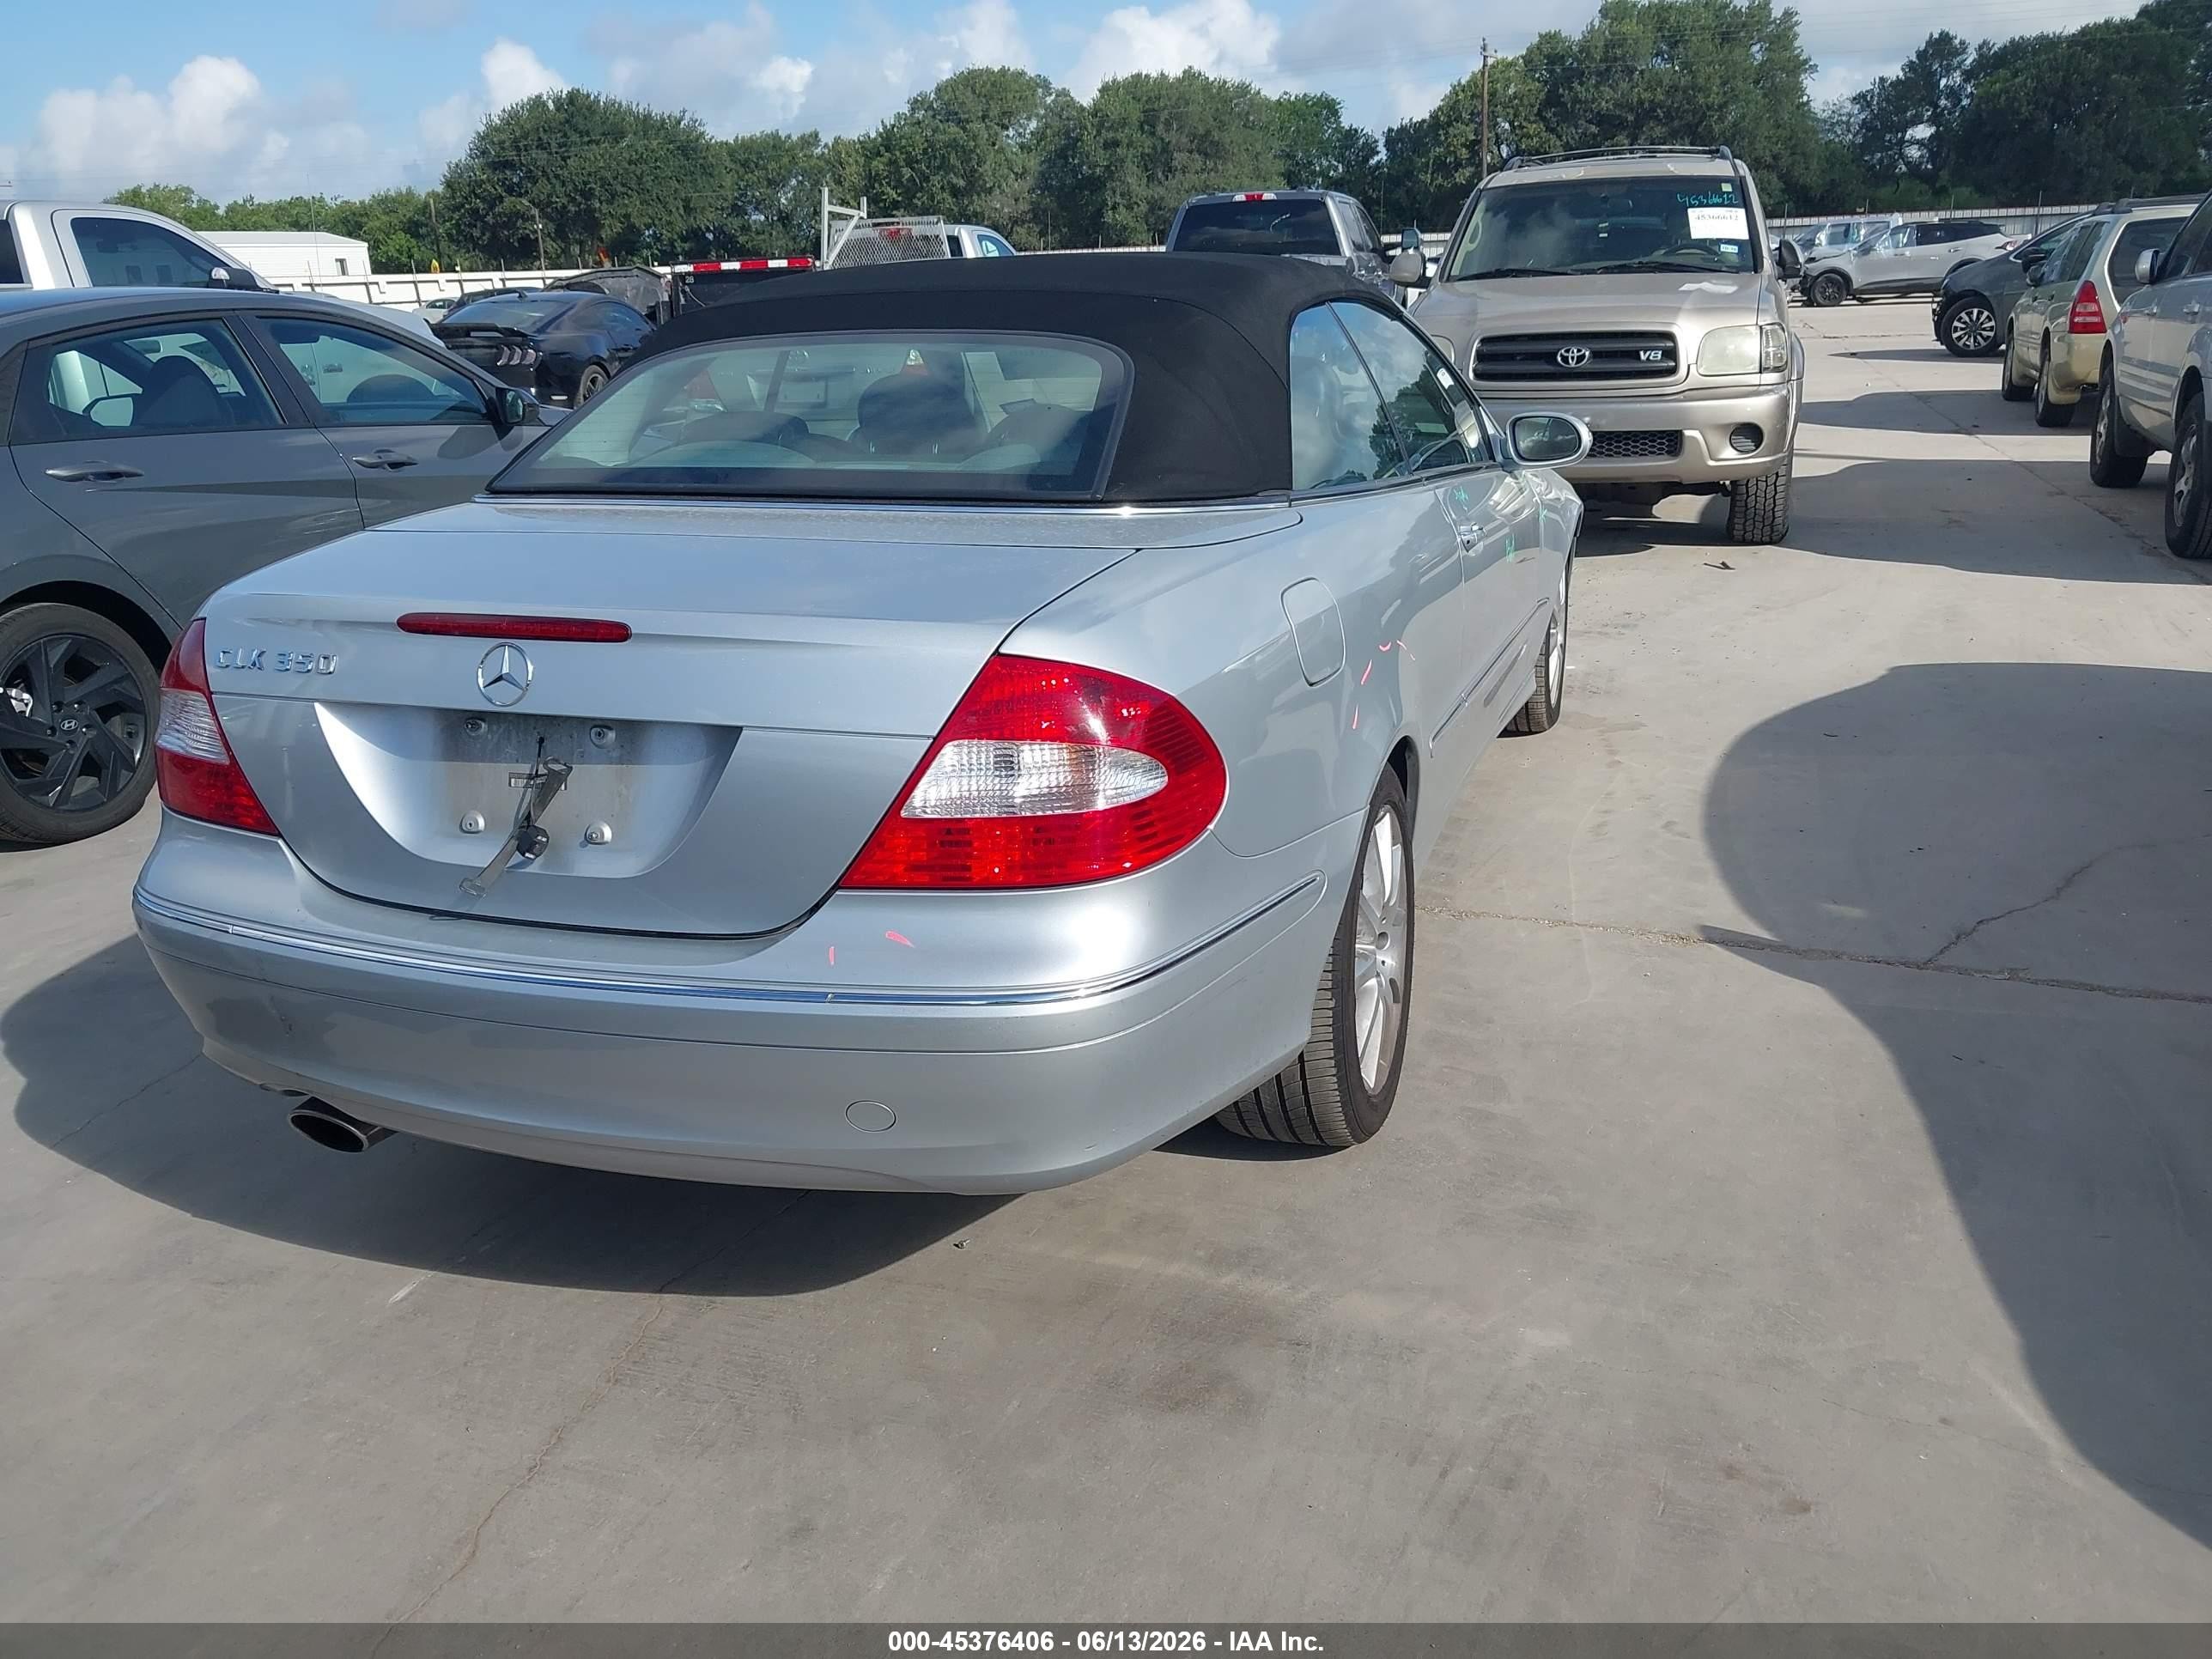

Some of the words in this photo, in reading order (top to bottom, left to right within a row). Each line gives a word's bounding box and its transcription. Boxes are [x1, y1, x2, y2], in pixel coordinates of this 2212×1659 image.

[1639, 349, 1662, 361] V8
[216, 647, 266, 671] CLK
[274, 652, 337, 674] 350
